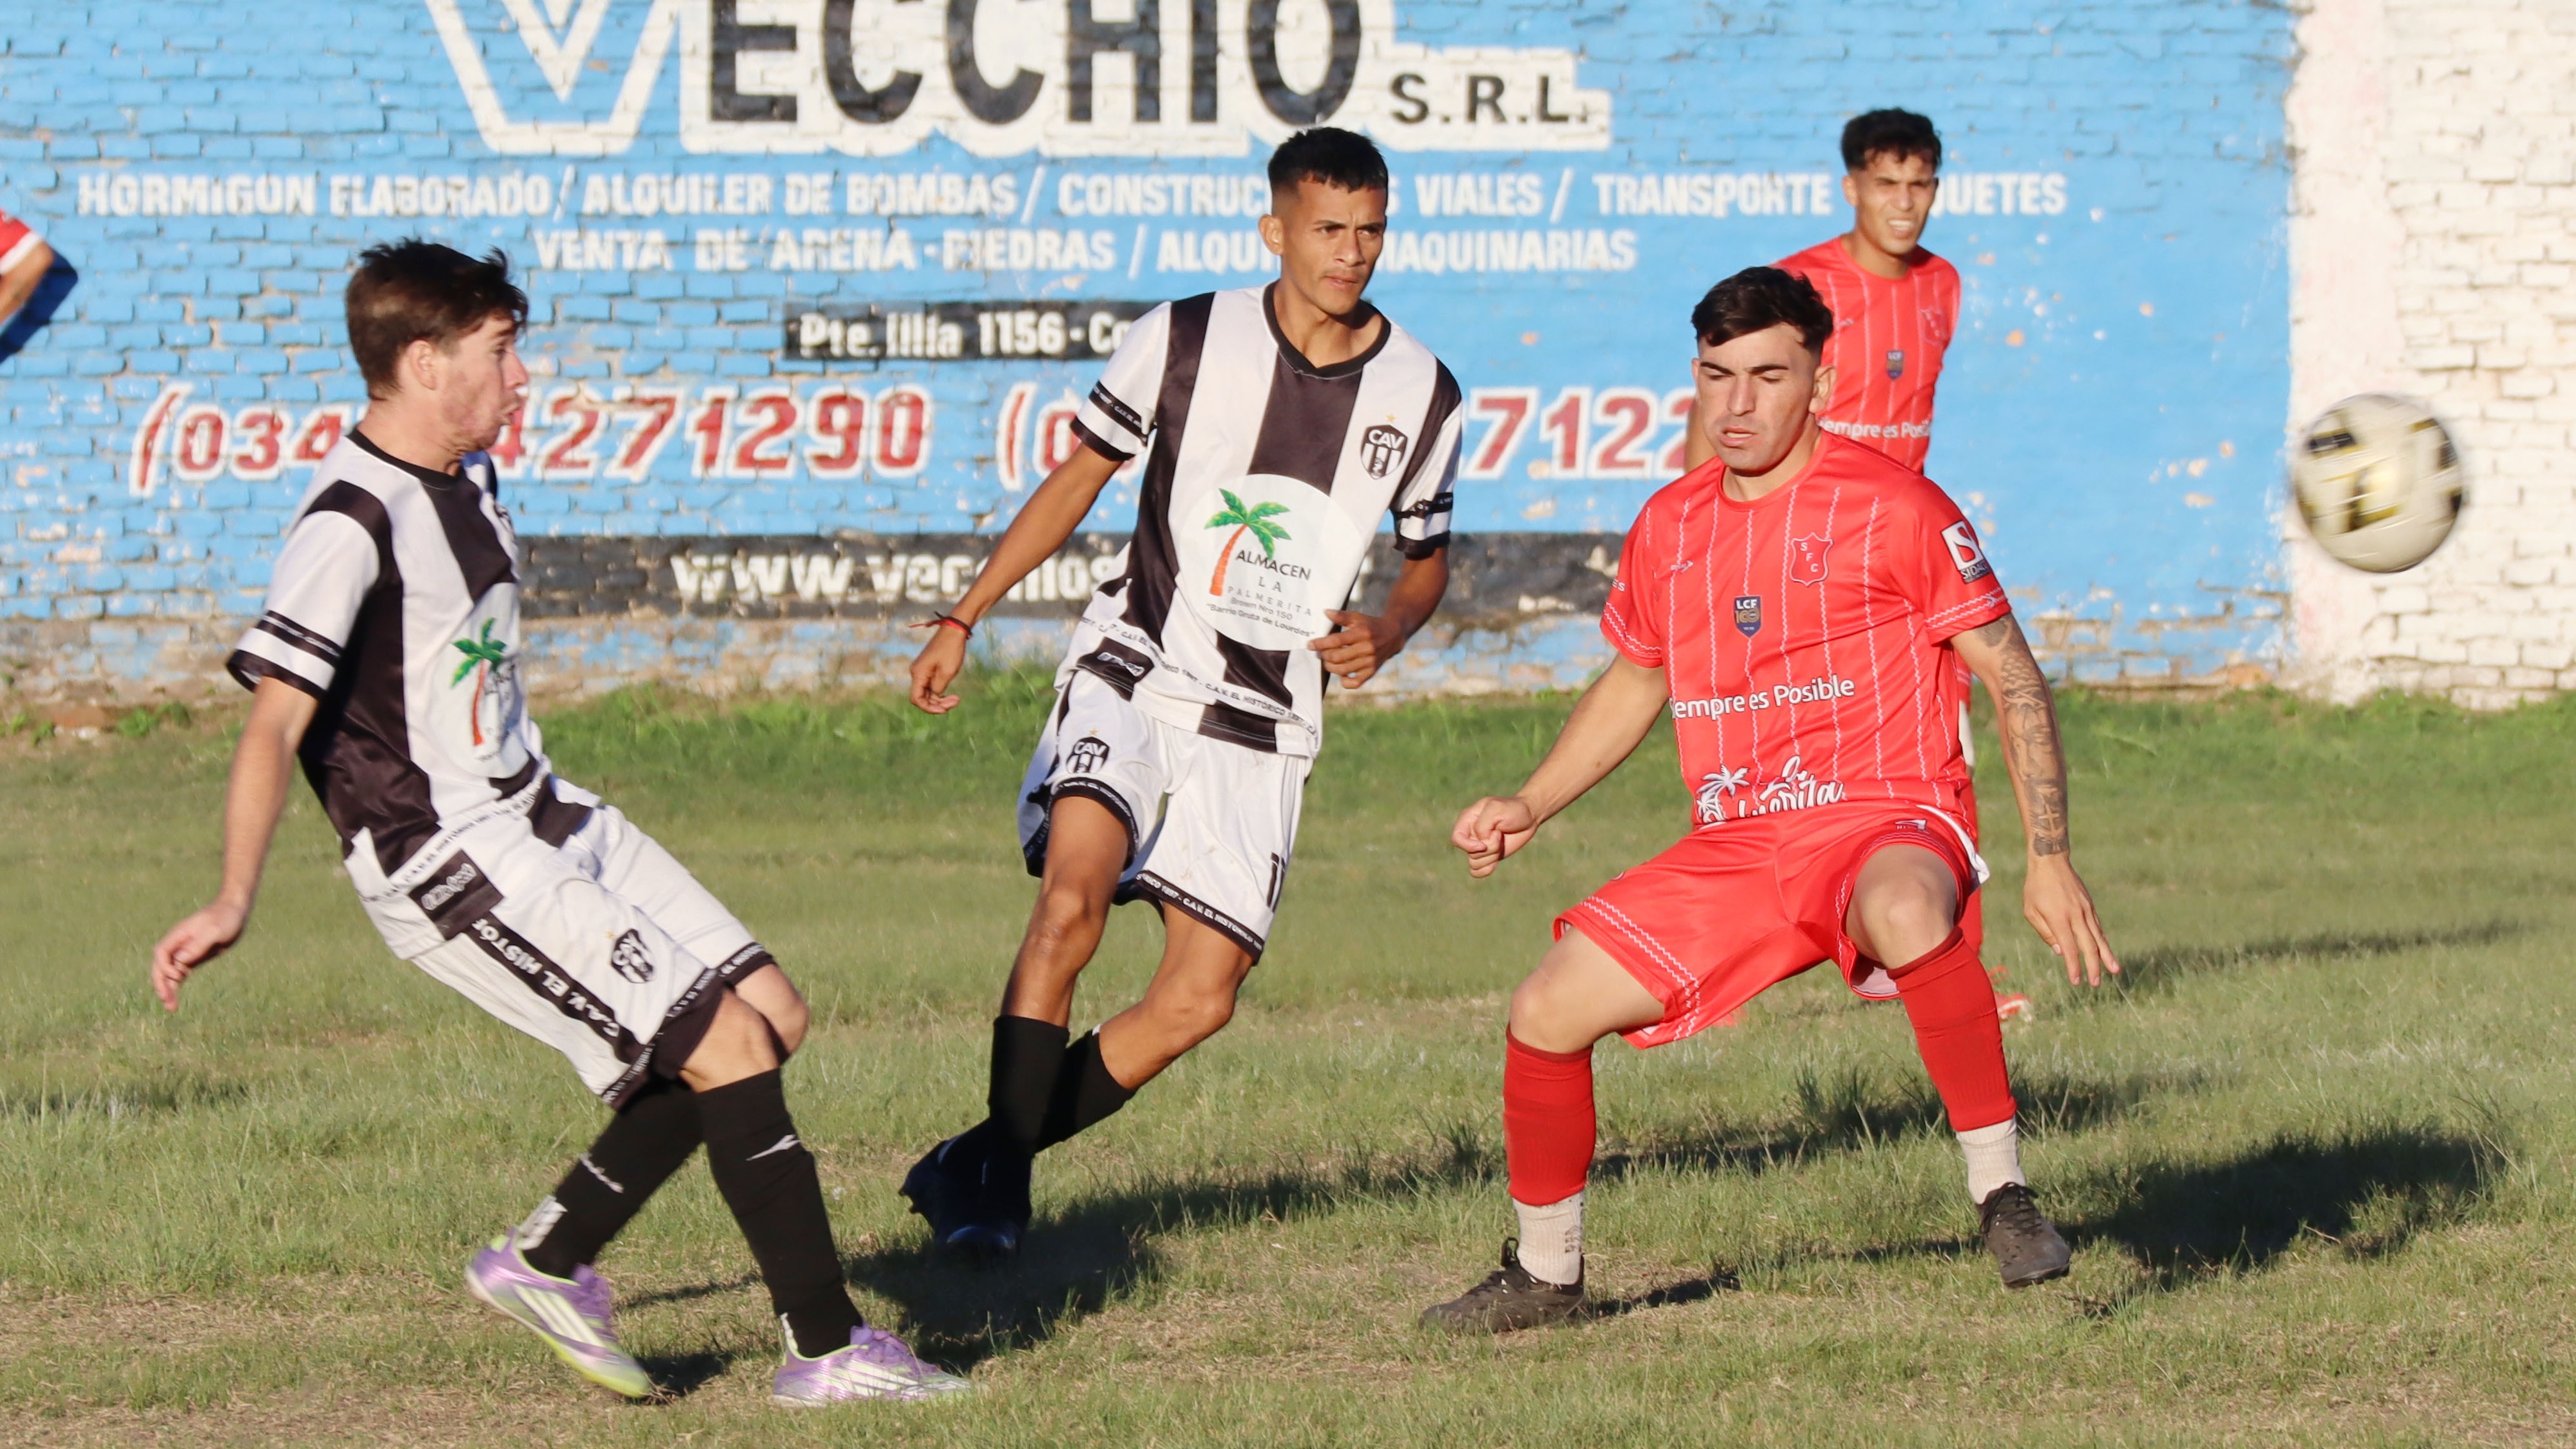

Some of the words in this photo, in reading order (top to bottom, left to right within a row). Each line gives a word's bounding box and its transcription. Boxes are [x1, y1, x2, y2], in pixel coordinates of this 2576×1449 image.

[1389, 74, 1589, 124] S.R.L.
[583, 173, 772, 215] ALQUILER
[785, 173, 833, 215] DE
[846, 173, 1017, 216] BOMBAS
[1058, 173, 1272, 217] CONSTRUC
[1415, 172, 1544, 217] VIALES
[1593, 172, 1832, 217] TRANSPORTE
[532, 229, 673, 272] VENTA
[694, 228, 750, 272] DE
[1156, 230, 1281, 274] ALQUI
[799, 312, 881, 358] Pte.
[1368, 429, 1405, 449] CAV
[1882, 424, 1899, 439] es
[1235, 549, 1312, 580] ALMACEN
[1735, 599, 1757, 610] LCF
[1748, 691, 1770, 710] es
[1773, 674, 1855, 707] Posible
[1073, 741, 1107, 756] CAV
